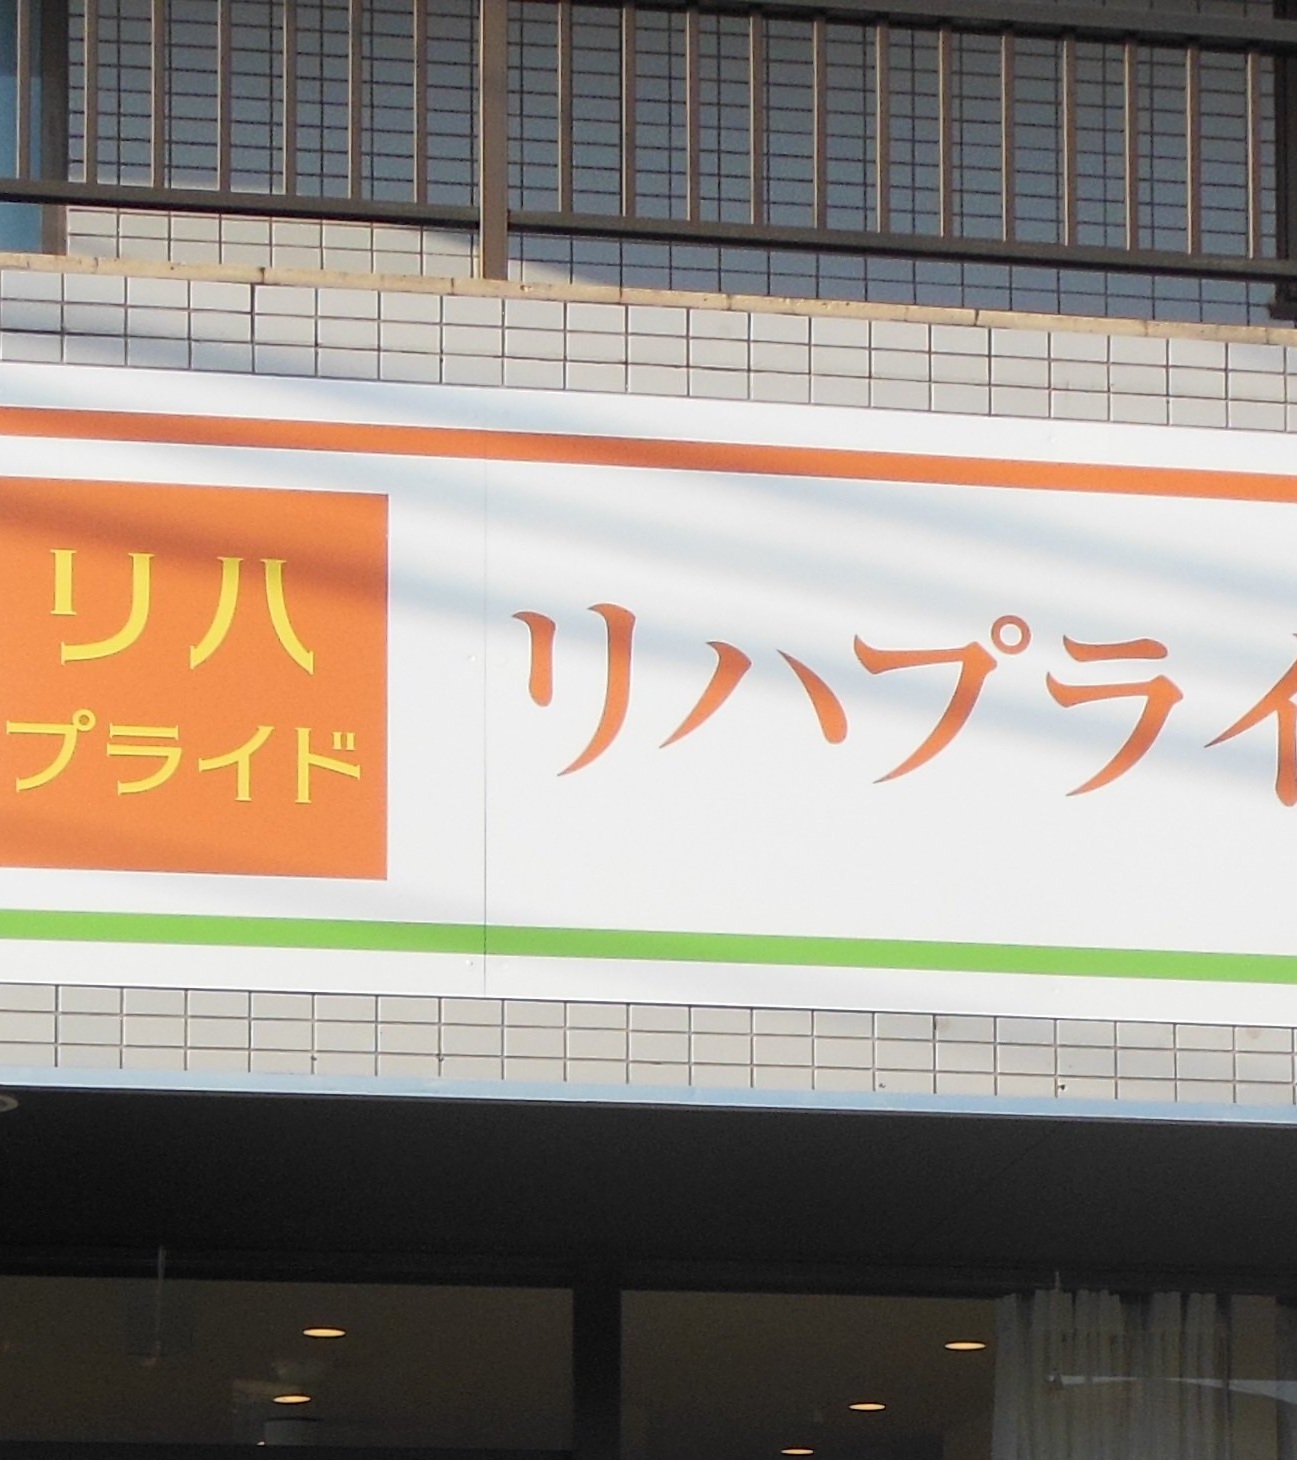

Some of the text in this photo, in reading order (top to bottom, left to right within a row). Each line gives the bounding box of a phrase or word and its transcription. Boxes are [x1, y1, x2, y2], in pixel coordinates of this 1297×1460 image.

[48, 547, 314, 677] リハ
[5, 707, 362, 806] プライド
